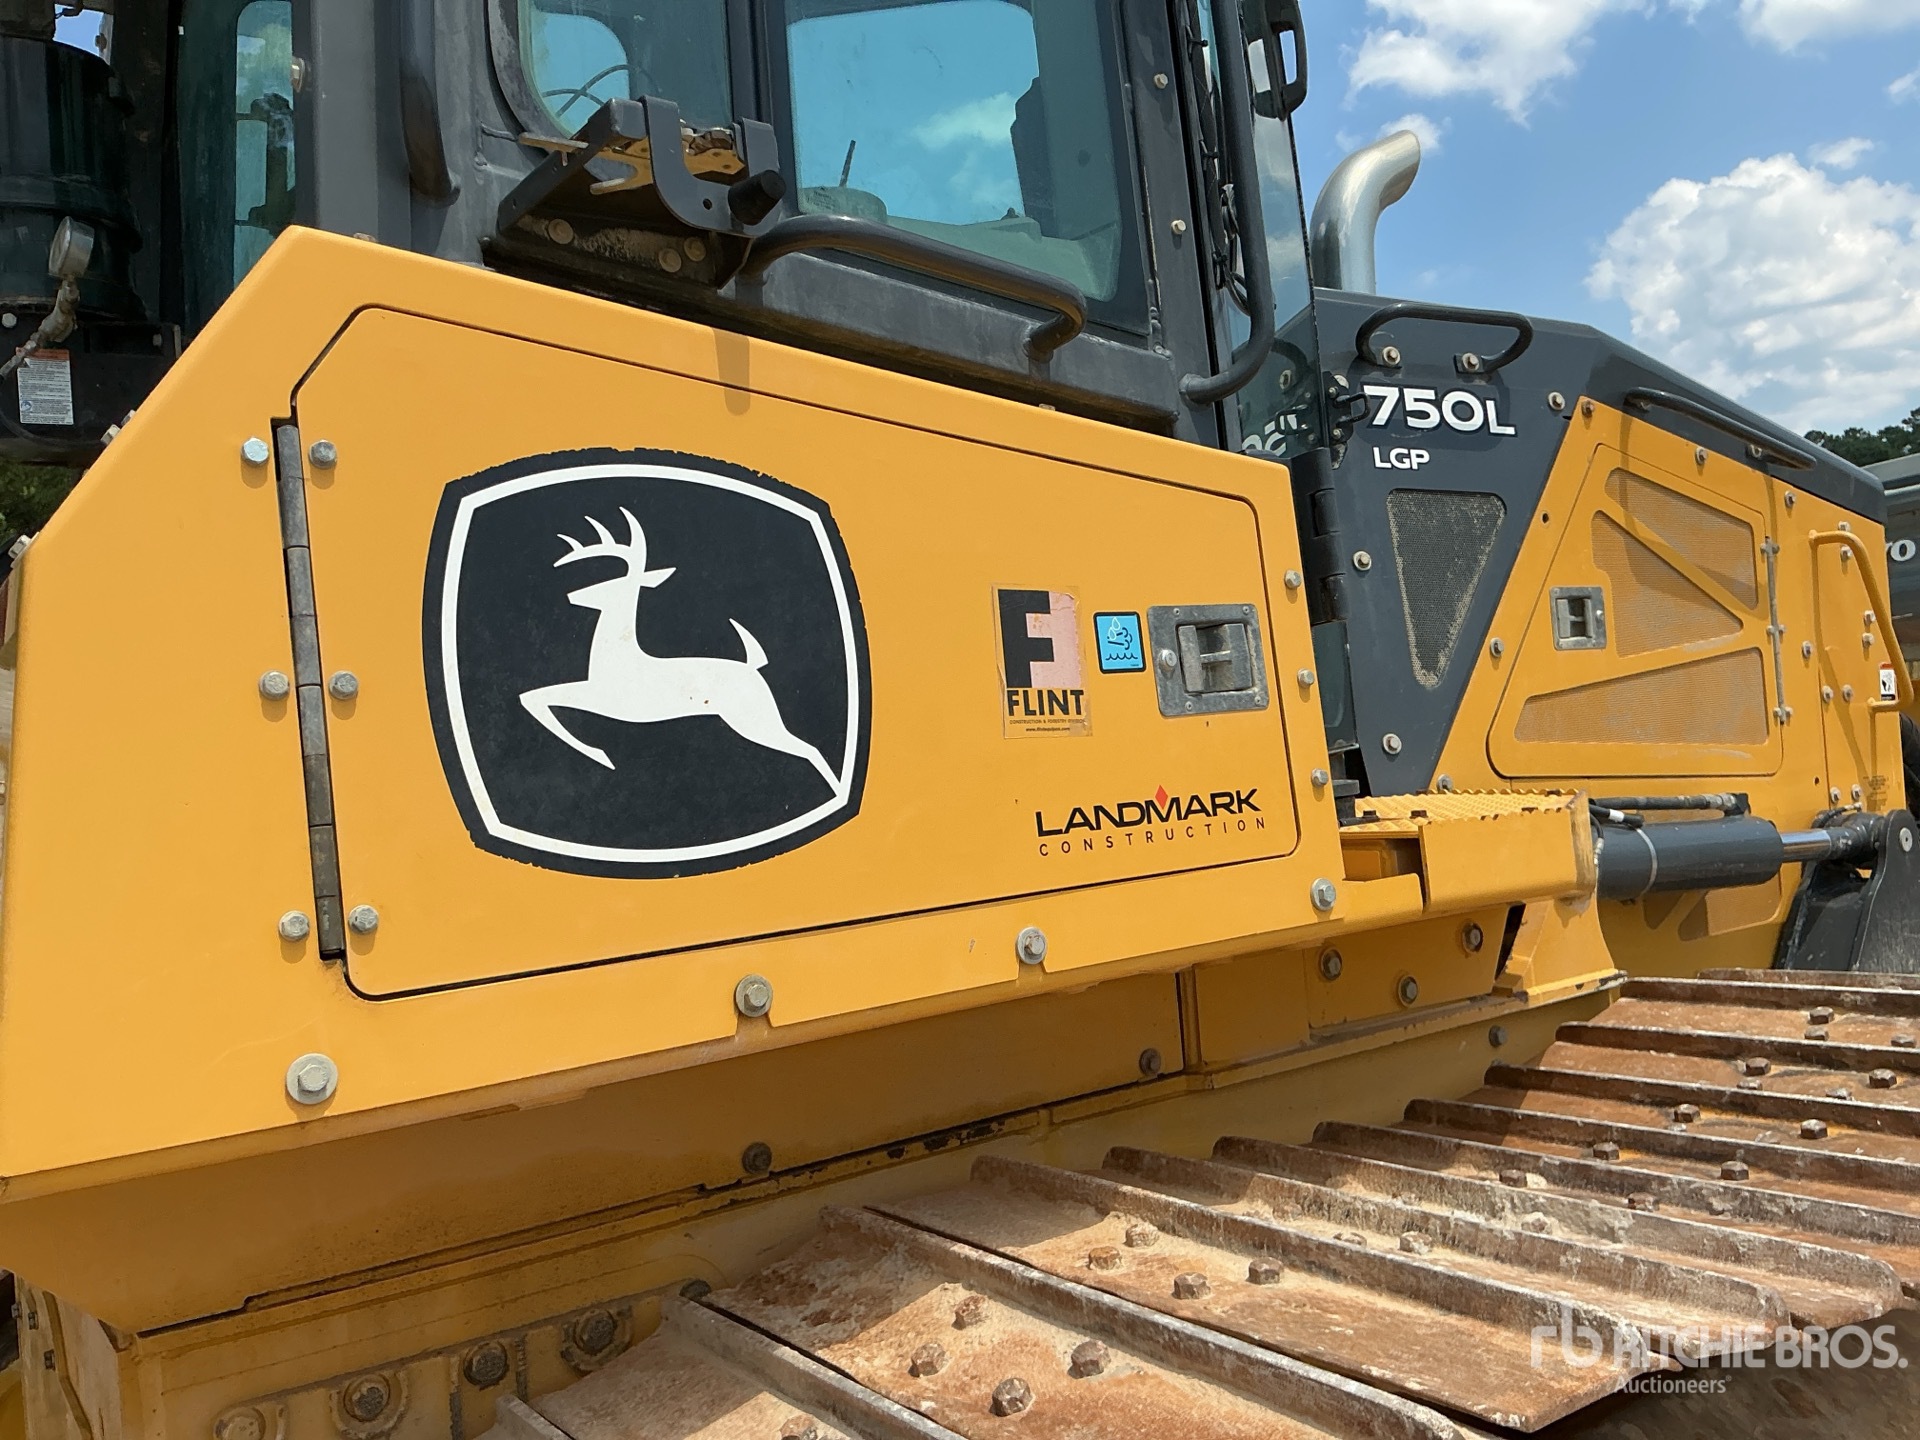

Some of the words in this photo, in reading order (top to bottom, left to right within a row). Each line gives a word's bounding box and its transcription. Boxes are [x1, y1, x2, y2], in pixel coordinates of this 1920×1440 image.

[1363, 384, 1516, 435] 750L
[1373, 447, 1430, 470] LGP
[1007, 690, 1084, 716] FLINT
[1036, 788, 1262, 837] LANDMARK
[1039, 817, 1266, 857] CONSTRUCTION
